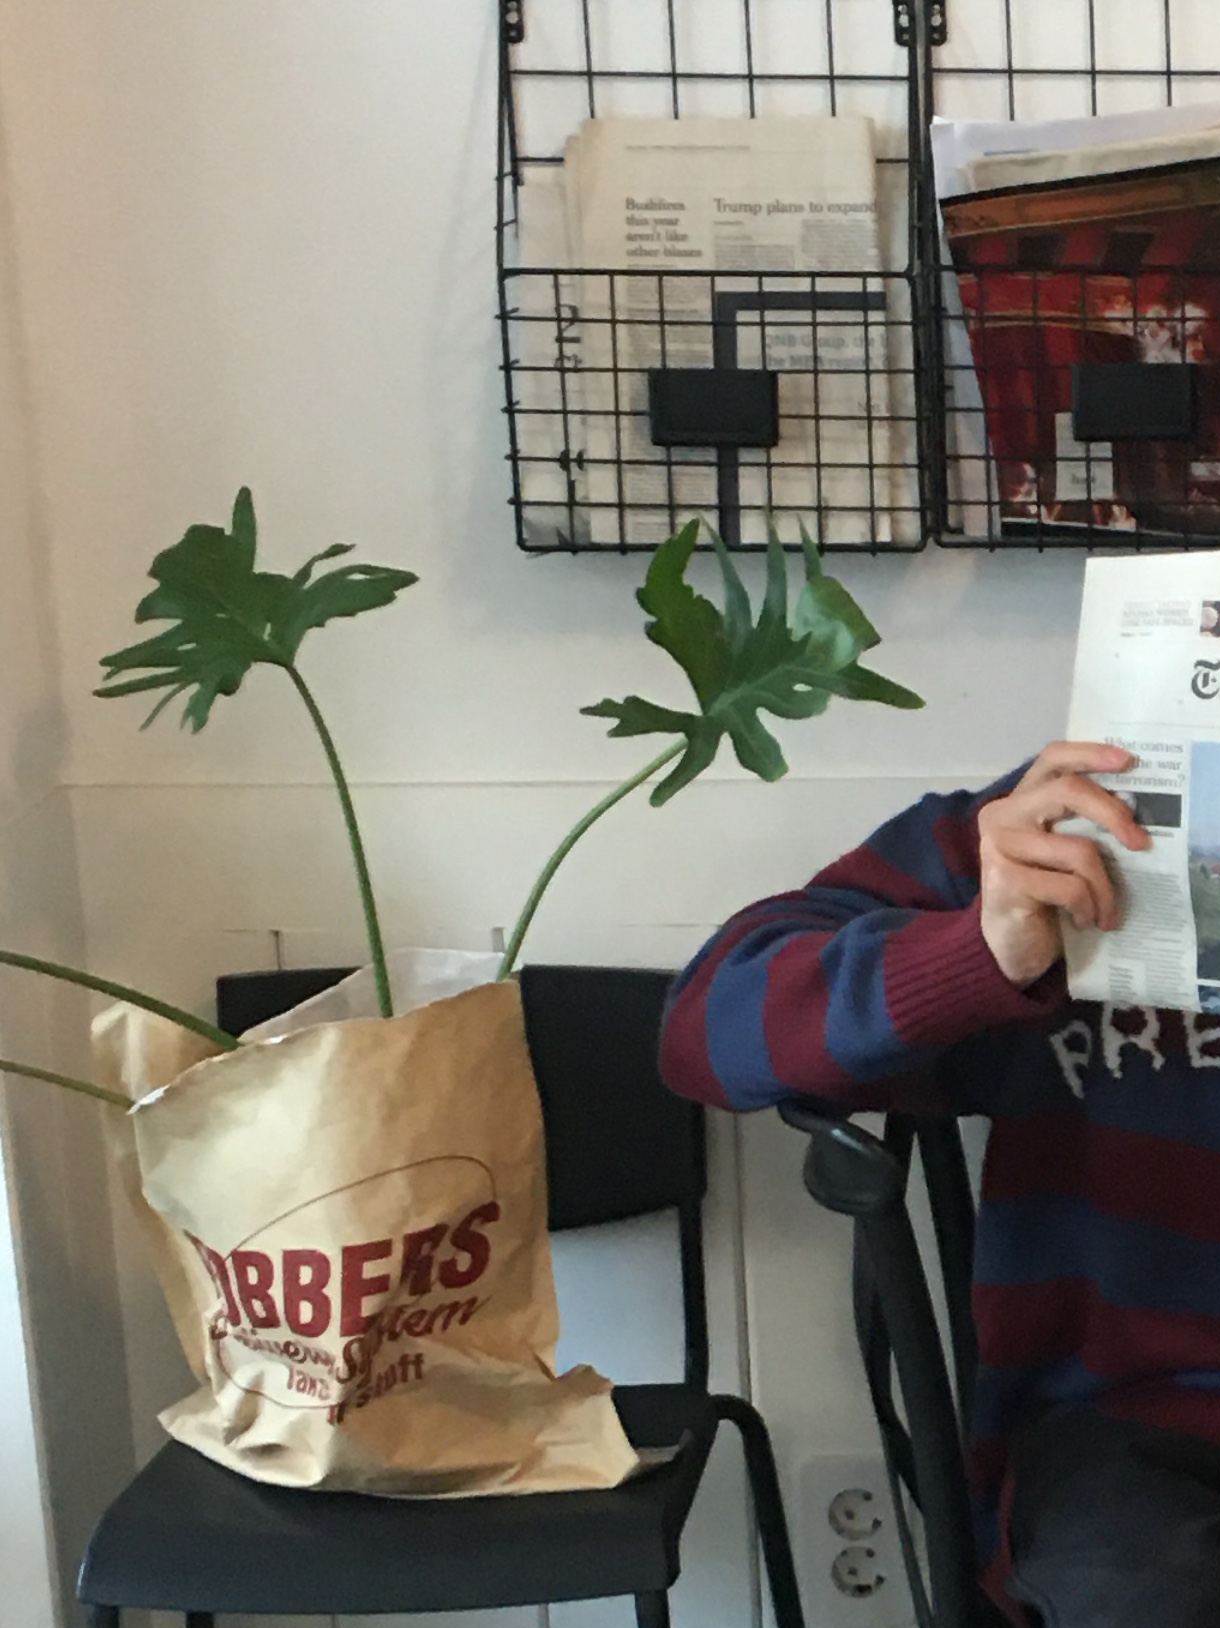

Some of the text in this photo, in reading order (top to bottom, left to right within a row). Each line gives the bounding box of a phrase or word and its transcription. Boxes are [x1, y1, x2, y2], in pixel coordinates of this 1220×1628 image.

[714, 198, 762, 216] Trump
[767, 199, 804, 215] plans
[809, 200, 823, 213] to
[1141, 742, 1183, 753] comes
[1157, 760, 1182, 770] war
